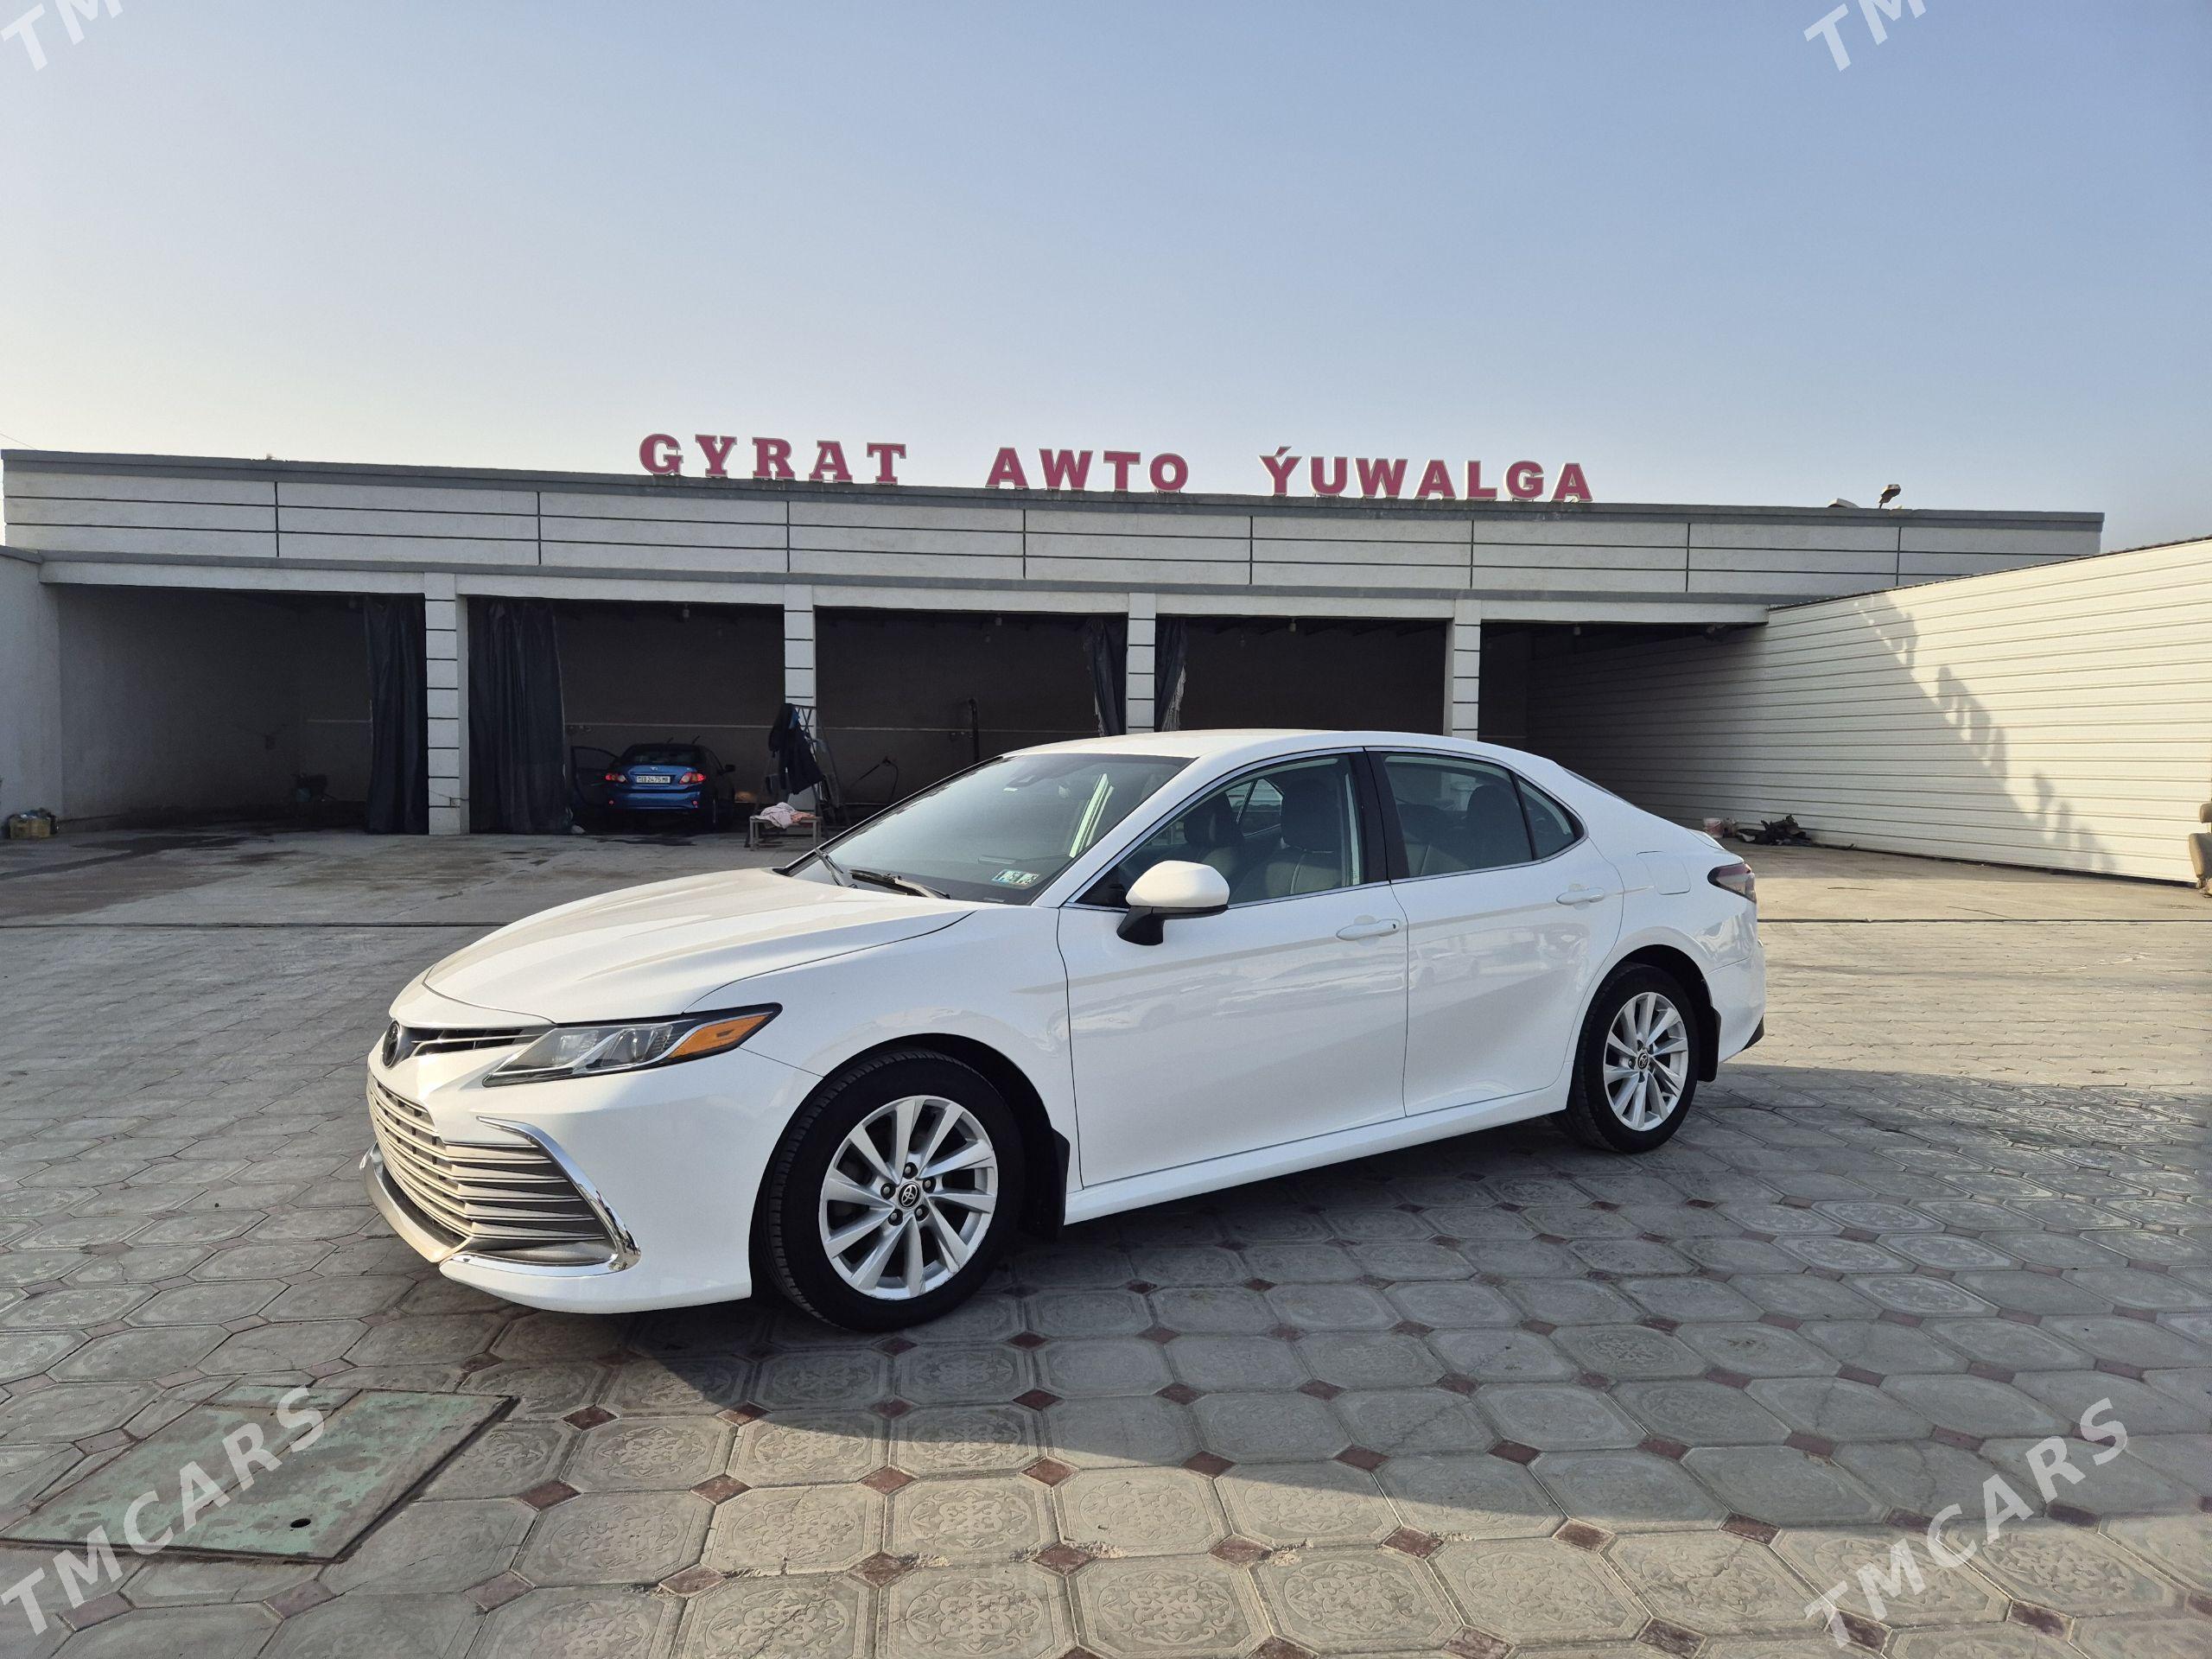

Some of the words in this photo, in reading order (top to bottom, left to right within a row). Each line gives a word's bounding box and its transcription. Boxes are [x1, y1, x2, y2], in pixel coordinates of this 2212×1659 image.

[640, 434, 906, 485] GYRAT
[985, 448, 1189, 493] AWTO
[1259, 446, 1592, 503] ÝUWALGA
